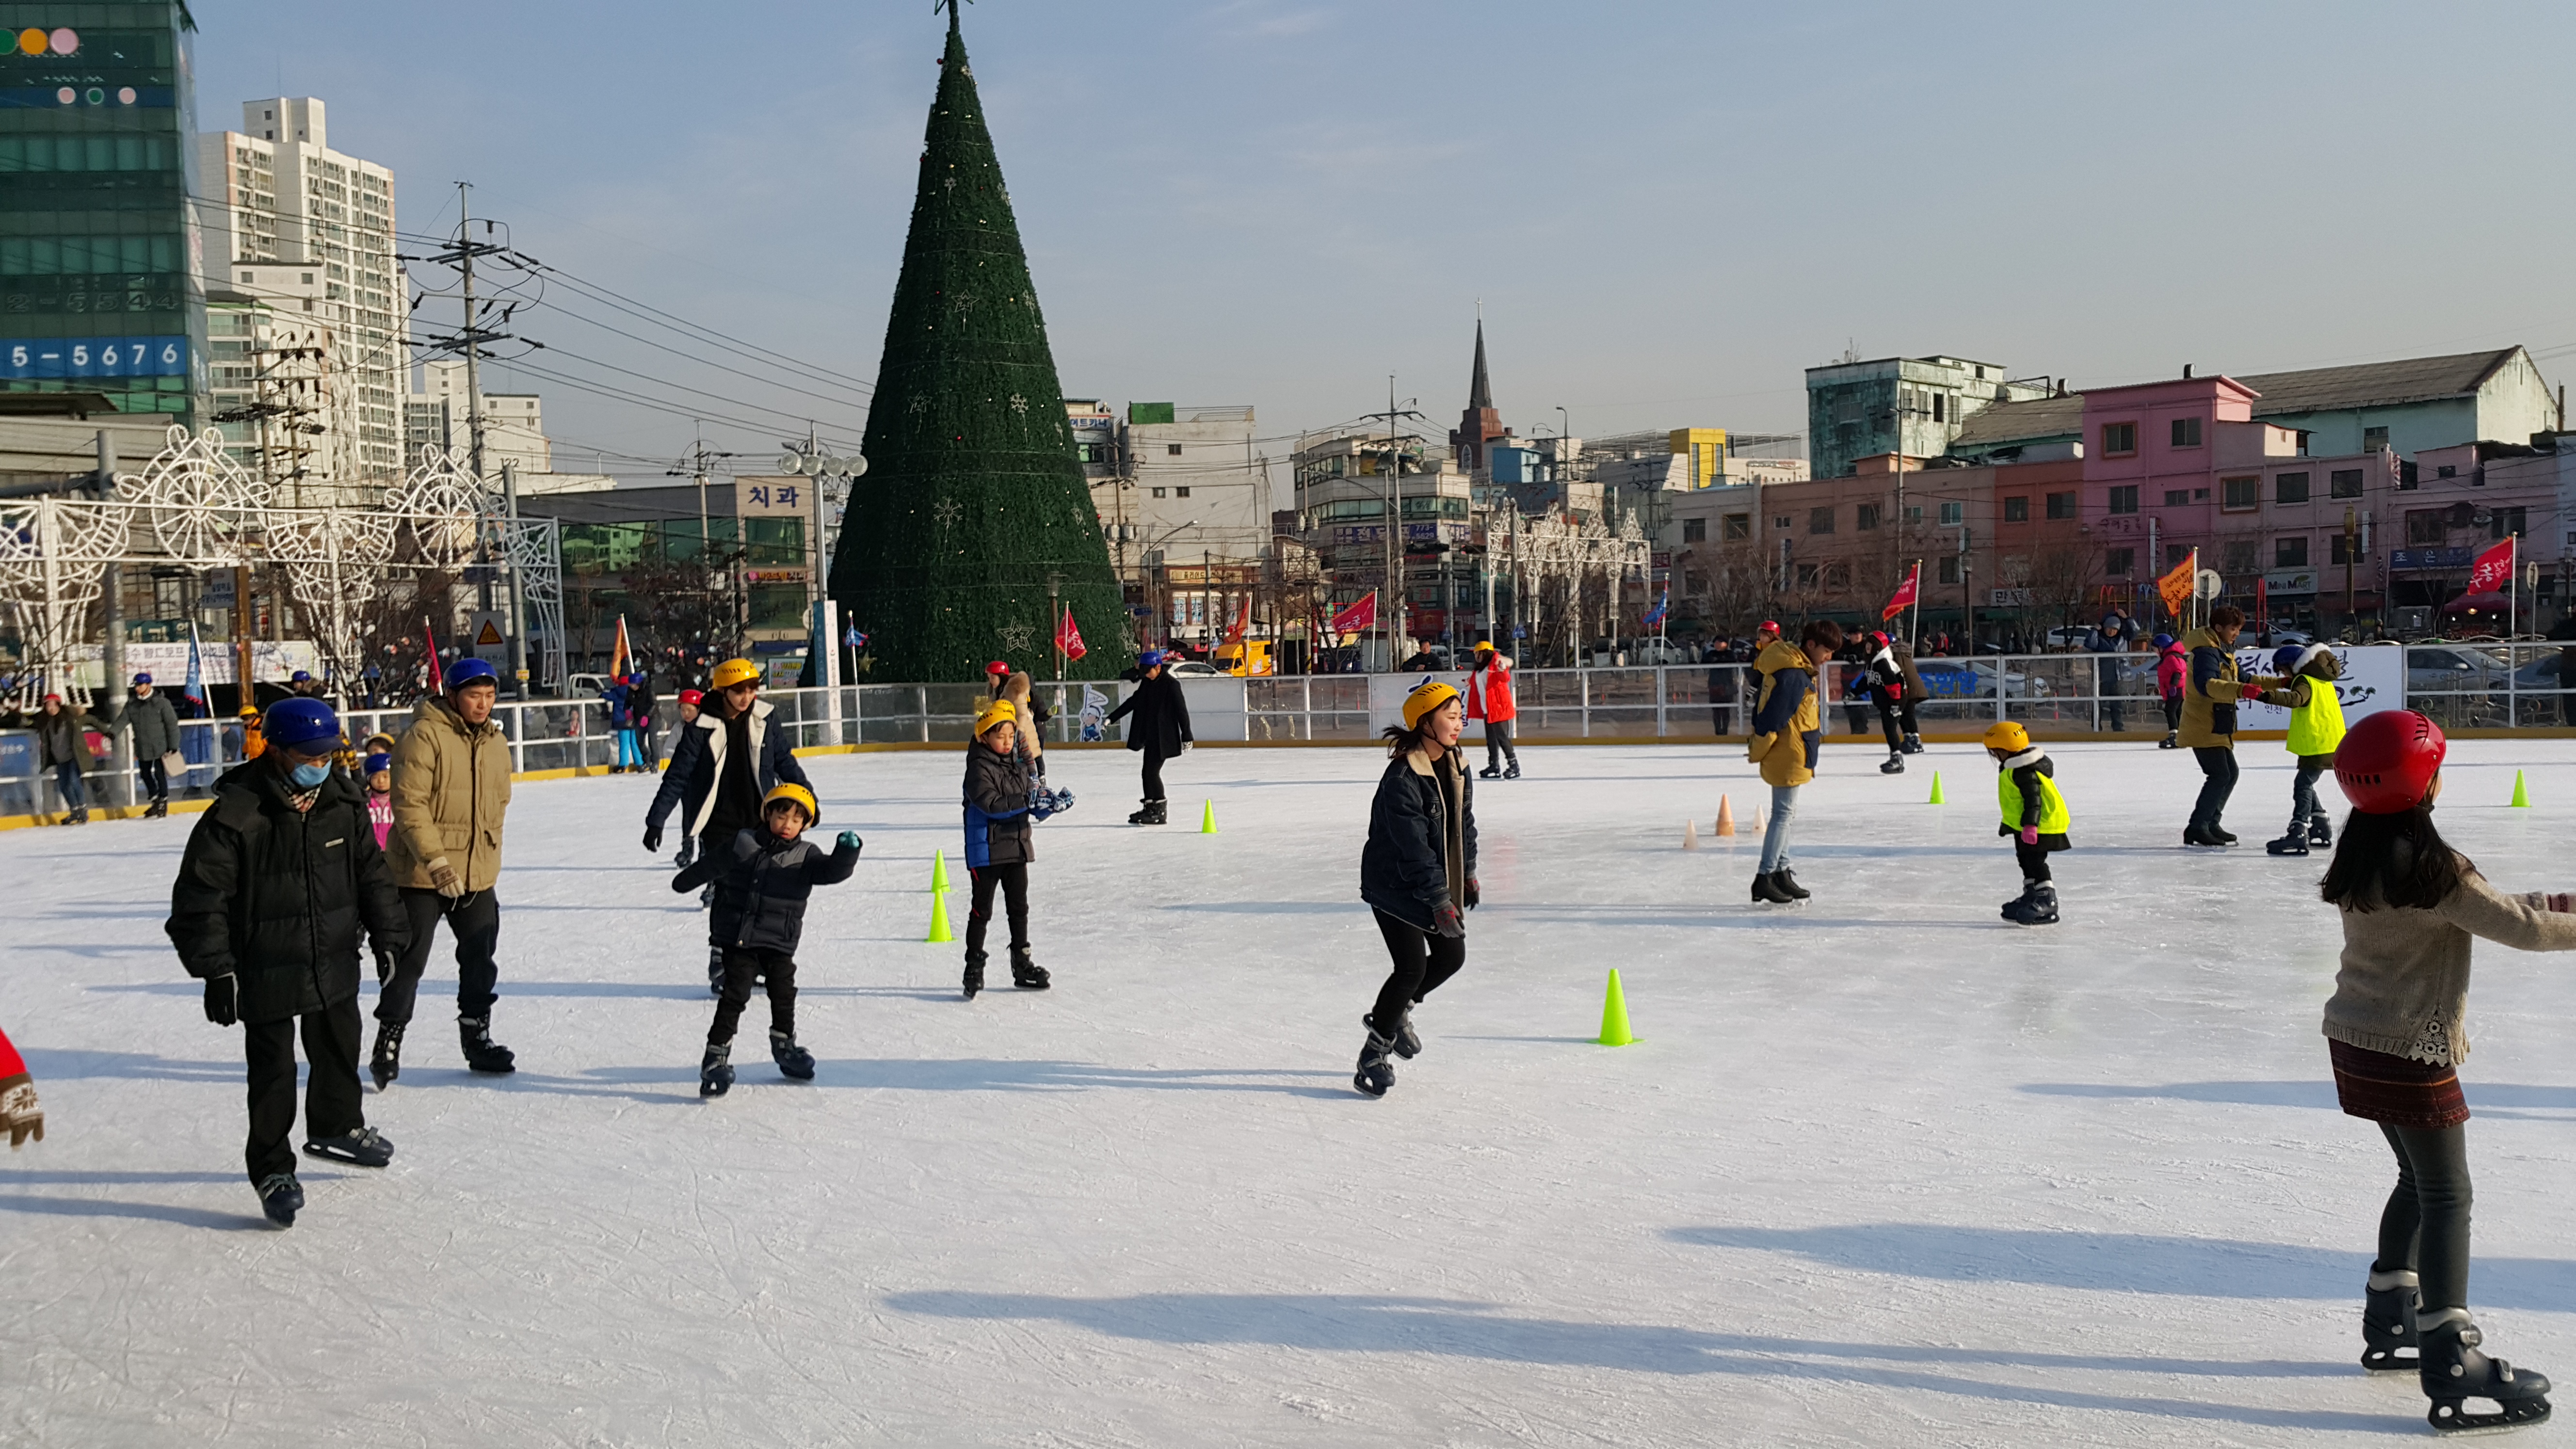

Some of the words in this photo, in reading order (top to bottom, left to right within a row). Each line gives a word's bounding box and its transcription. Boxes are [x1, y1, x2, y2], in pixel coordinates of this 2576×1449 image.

[12, 343, 178, 368] 5-5676
[748, 486, 799, 508] 치과
[2265, 705, 2282, 714] 인천
